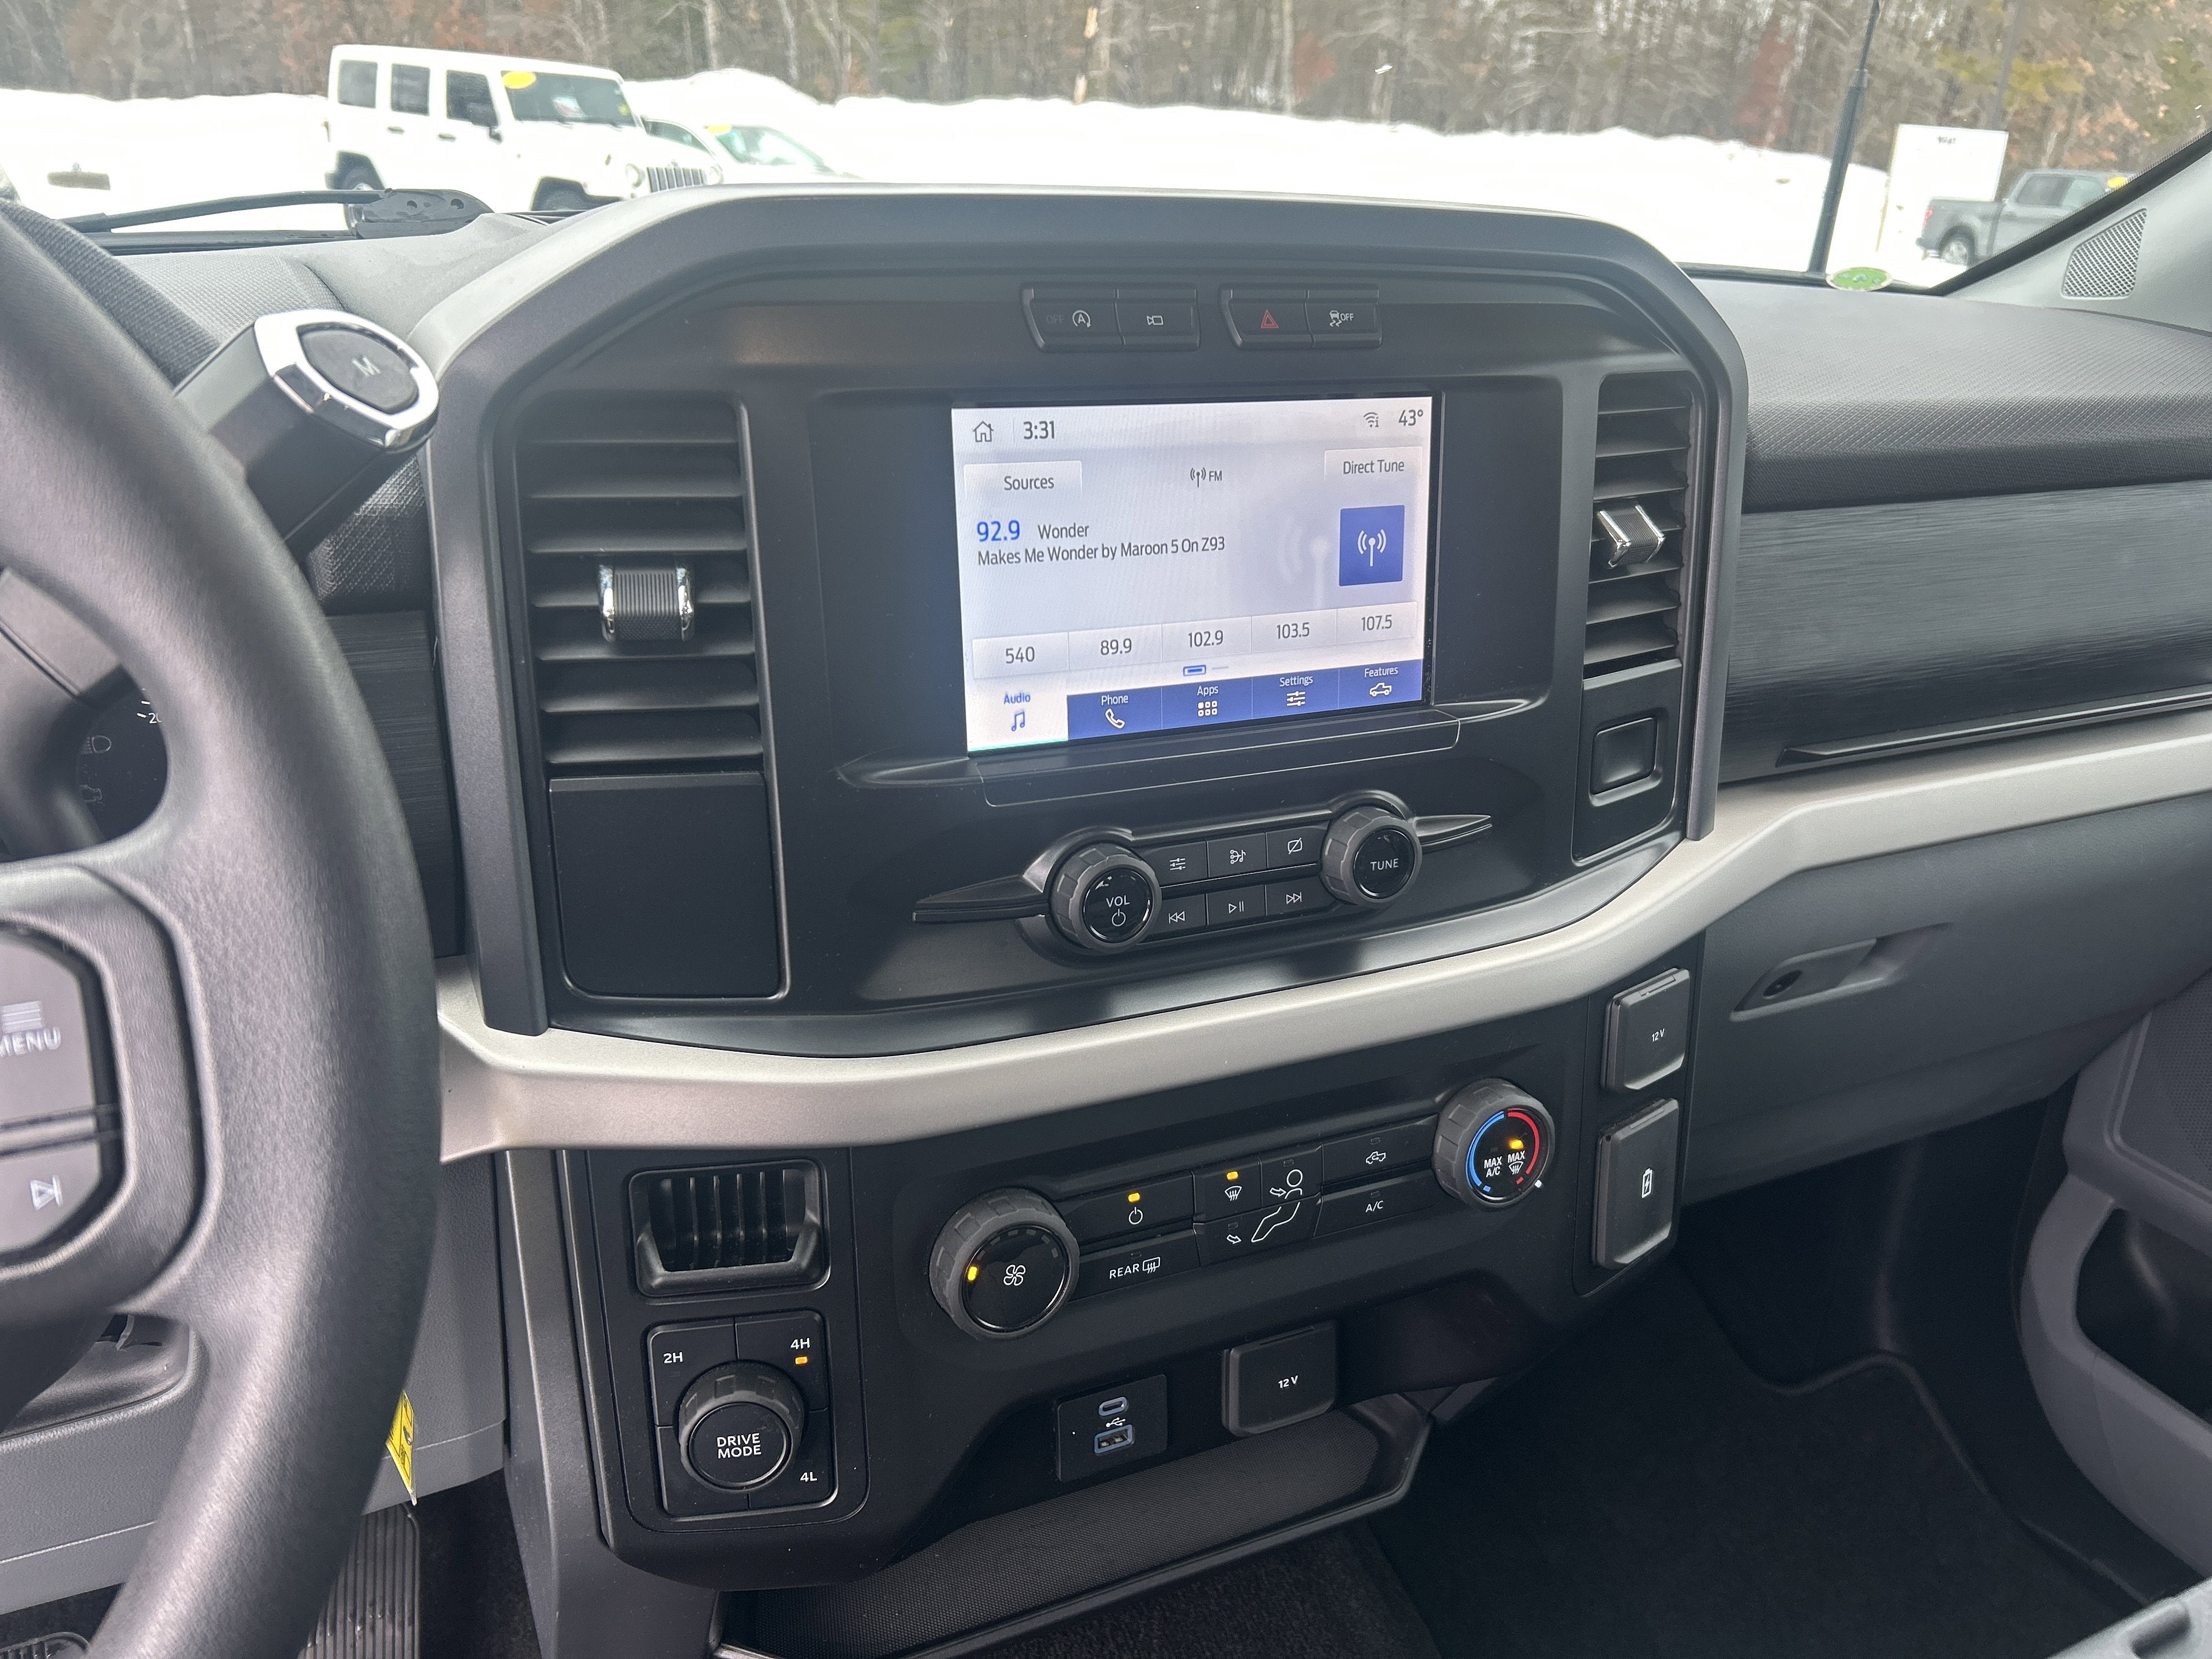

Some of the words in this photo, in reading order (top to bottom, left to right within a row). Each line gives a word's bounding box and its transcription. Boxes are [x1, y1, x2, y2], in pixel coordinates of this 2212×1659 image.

[1340, 312, 1354, 323] OFF
[352, 356, 381, 377] M
[1398, 409, 1424, 427] 43°
[1023, 420, 1056, 439] 3:31
[1342, 460, 1375, 475] Direct
[1376, 459, 1404, 473] Tune
[1003, 476, 1054, 490] Sources
[1209, 470, 1222, 482] FM
[977, 520, 1020, 543] 92.9
[1037, 523, 1090, 539] Wonder
[978, 550, 1021, 566] Makes
[1025, 548, 1045, 563] Me
[1047, 544, 1098, 561] Wonder
[1101, 542, 1116, 560] by
[1121, 540, 1168, 557] Maroon
[1171, 539, 1179, 554] 5
[1181, 538, 1199, 553] On
[1201, 536, 1225, 552] Z93
[1361, 614, 1392, 631] 107.5
[1277, 622, 1310, 640] 103.5
[1188, 630, 1224, 648] 102.9
[1100, 638, 1132, 656] 89.9
[1005, 646, 1035, 664] 540
[1364, 665, 1398, 678] Features
[1279, 674, 1313, 687] Settings
[1197, 685, 1218, 697] Apps
[1003, 692, 1031, 705] Audio
[1101, 694, 1128, 706] Phone
[1370, 857, 1400, 871] TUNE
[1105, 895, 1130, 908] VOL
[1651, 1031, 1659, 1042] 12
[1660, 1028, 1665, 1037] V
[1483, 1156, 1502, 1169] MAX
[1507, 1150, 1526, 1163] MAX
[1486, 1166, 1501, 1178] A/C
[1365, 1200, 1384, 1213] A/C
[1109, 1263, 1139, 1279] REAR
[790, 1338, 810, 1350] 4H
[663, 1351, 684, 1364] 2H
[1278, 1378, 1289, 1389] 12
[1291, 1375, 1299, 1384] V
[716, 1432, 761, 1447] DRIVE
[718, 1444, 762, 1459] MODE
[800, 1471, 818, 1482] 4L
